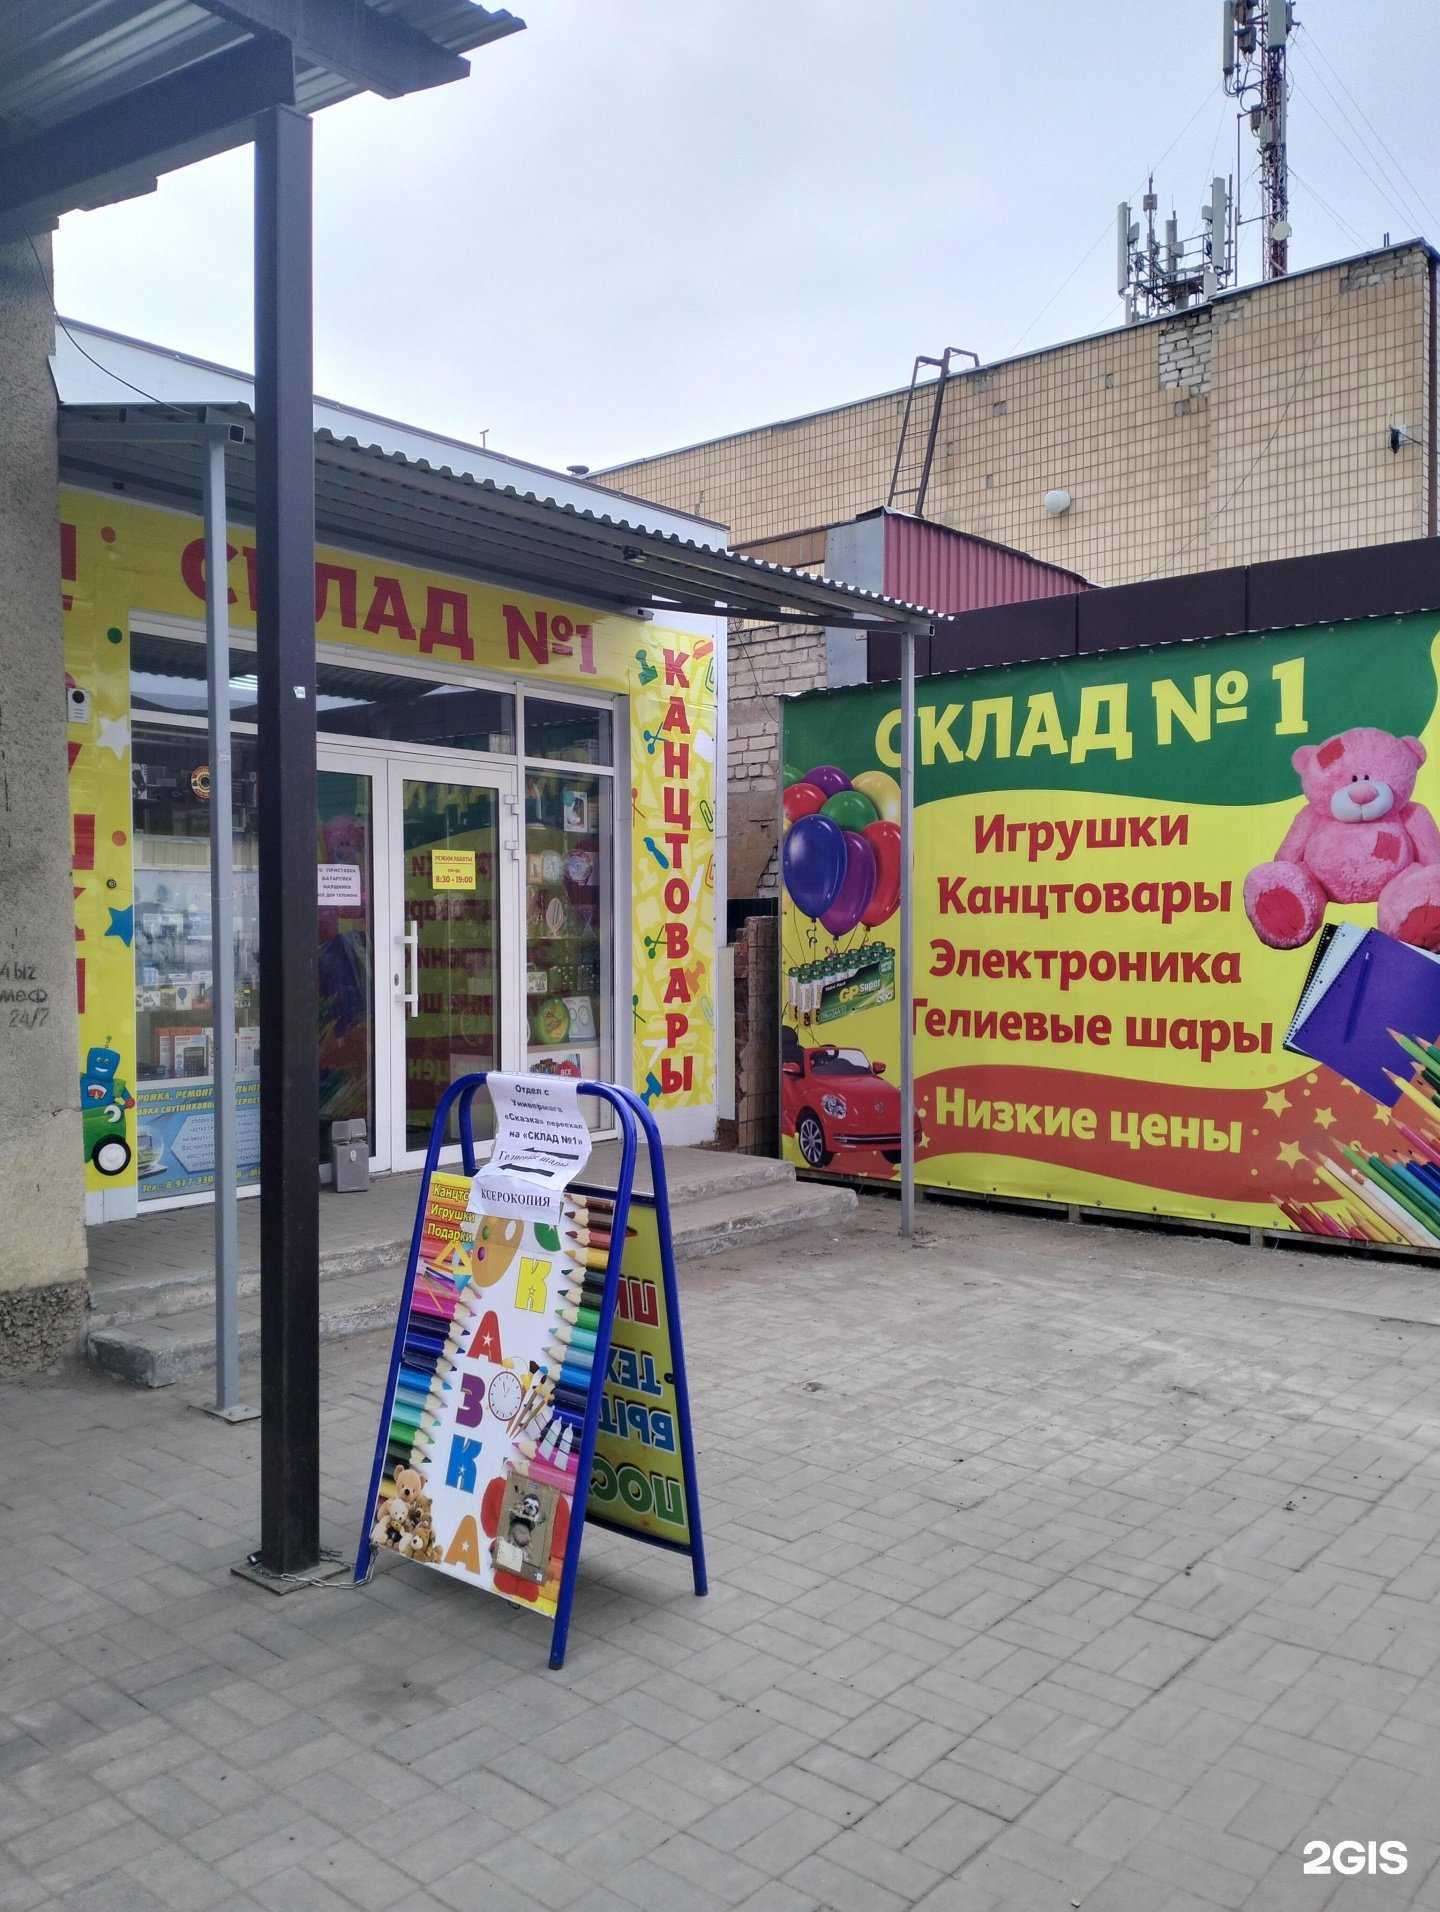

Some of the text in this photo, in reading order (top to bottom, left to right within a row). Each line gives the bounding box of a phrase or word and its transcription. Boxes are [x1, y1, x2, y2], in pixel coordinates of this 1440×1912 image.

[502, 604, 597, 674] №1
[874, 683, 1133, 769] СКЛАД
[973, 813, 1190, 862] Игрушки
[660, 647, 693, 1094] КАНЦТОВАРЫ
[936, 875, 1233, 924] Канцтовары
[928, 939, 1242, 991] Электроника
[840, 985, 859, 1002] GP
[859, 979, 880, 992] Super
[912, 998, 1273, 1062] Гелиевые шары
[515, 1084, 549, 1096] Отдел с
[509, 1130, 583, 1146] на «СКЛАД №1»
[934, 1085, 1243, 1154] Низкие цены
[431, 1203, 476, 1223] Игрушки
[433, 1183, 470, 1202] Канцто
[481, 1188, 551, 1208] КСЕРОКОПИЯ
[427, 1222, 474, 1243] Подарки
[588, 1455, 687, 1529] ПОС
